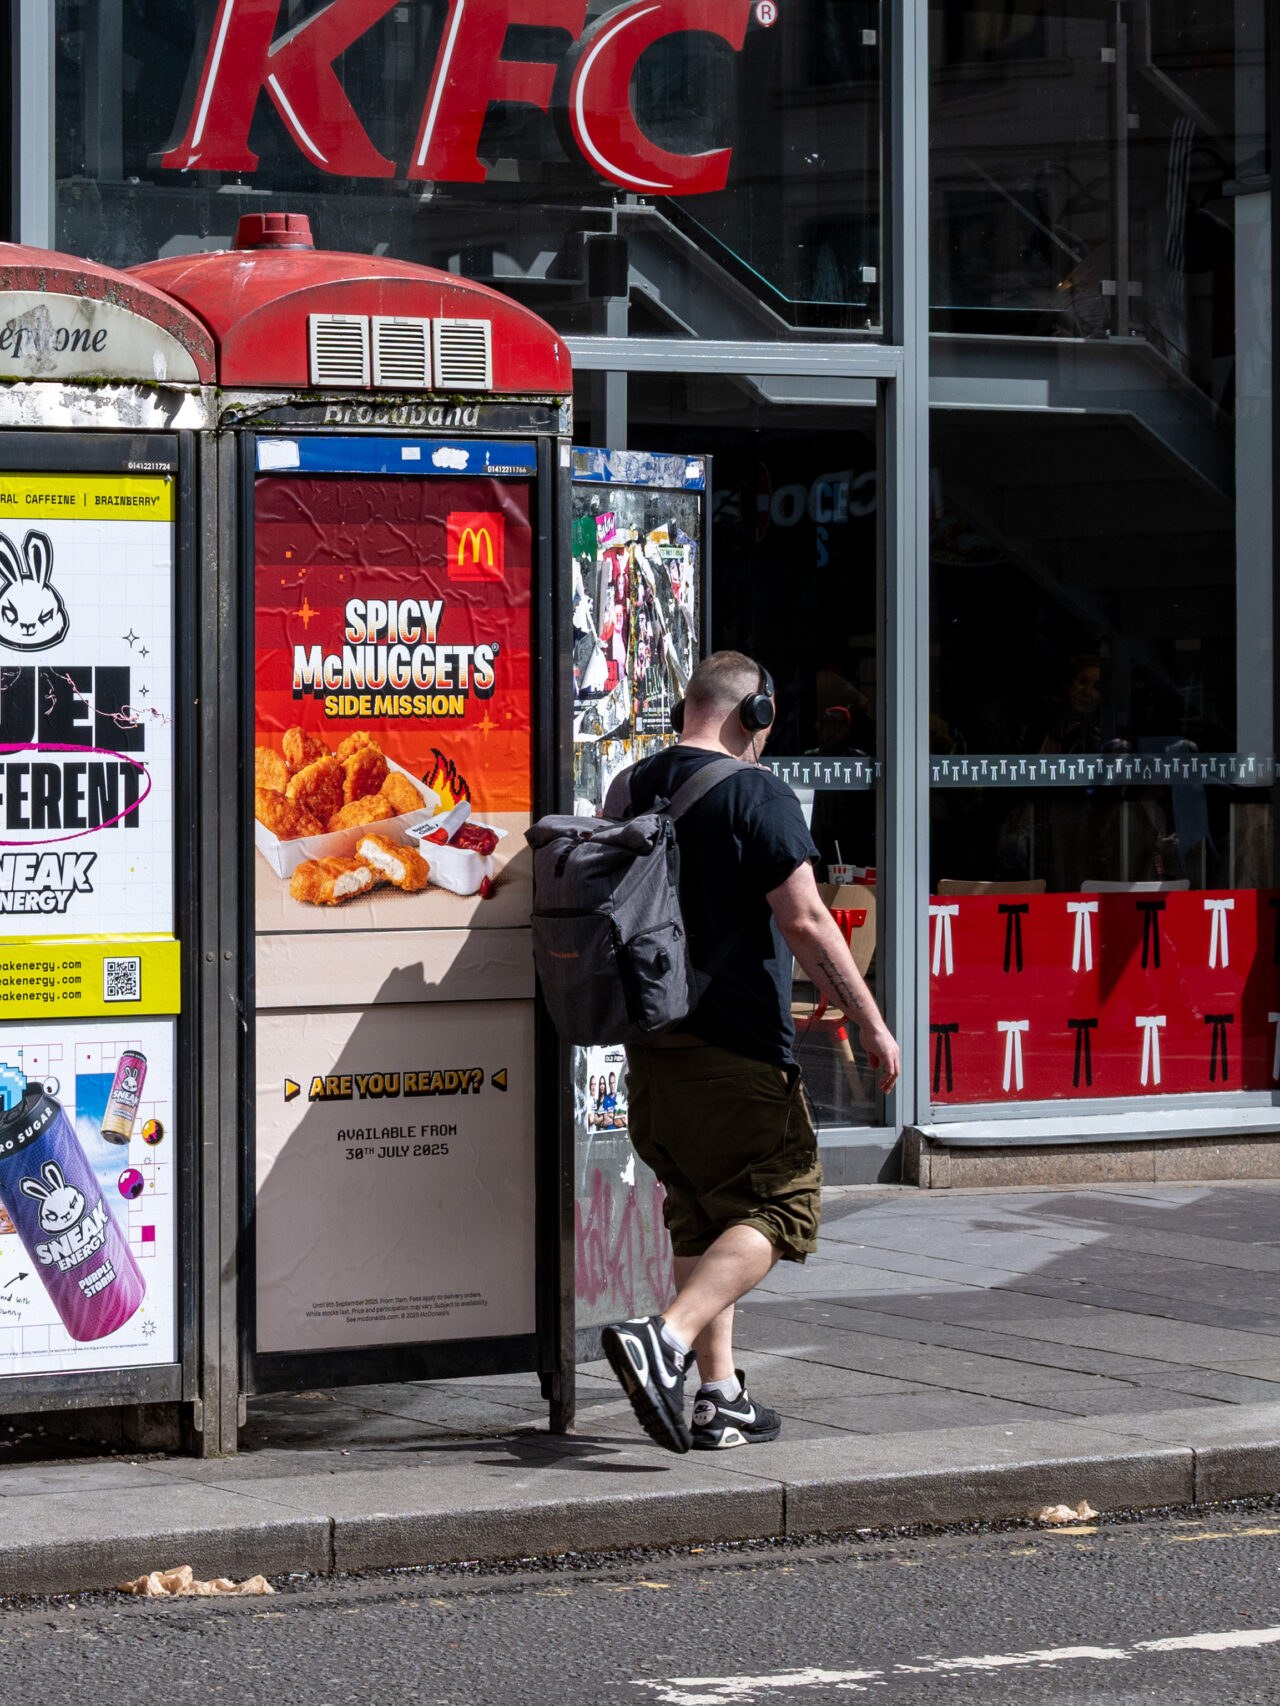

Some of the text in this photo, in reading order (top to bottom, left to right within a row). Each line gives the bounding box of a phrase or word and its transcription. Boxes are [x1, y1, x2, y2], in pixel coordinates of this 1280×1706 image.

[128, 462, 171, 470] 01412211724
[25, 494, 76, 505] CAFFEINE
[345, 598, 444, 646] SPICY
[325, 695, 465, 717] SIDE MISSION
[308, 1068, 484, 1102] ARE YOU READY?
[17, 1107, 53, 1144] SUGAR
[337, 1124, 457, 1141] AVAILABLE FROM
[345, 1143, 449, 1160] 30TH JULY 2025
[34, 1198, 109, 1266] SNEAK
[57, 1229, 110, 1273] ENERGY
[78, 1259, 114, 1292] PURPLE
[83, 1272, 117, 1299] STORM
